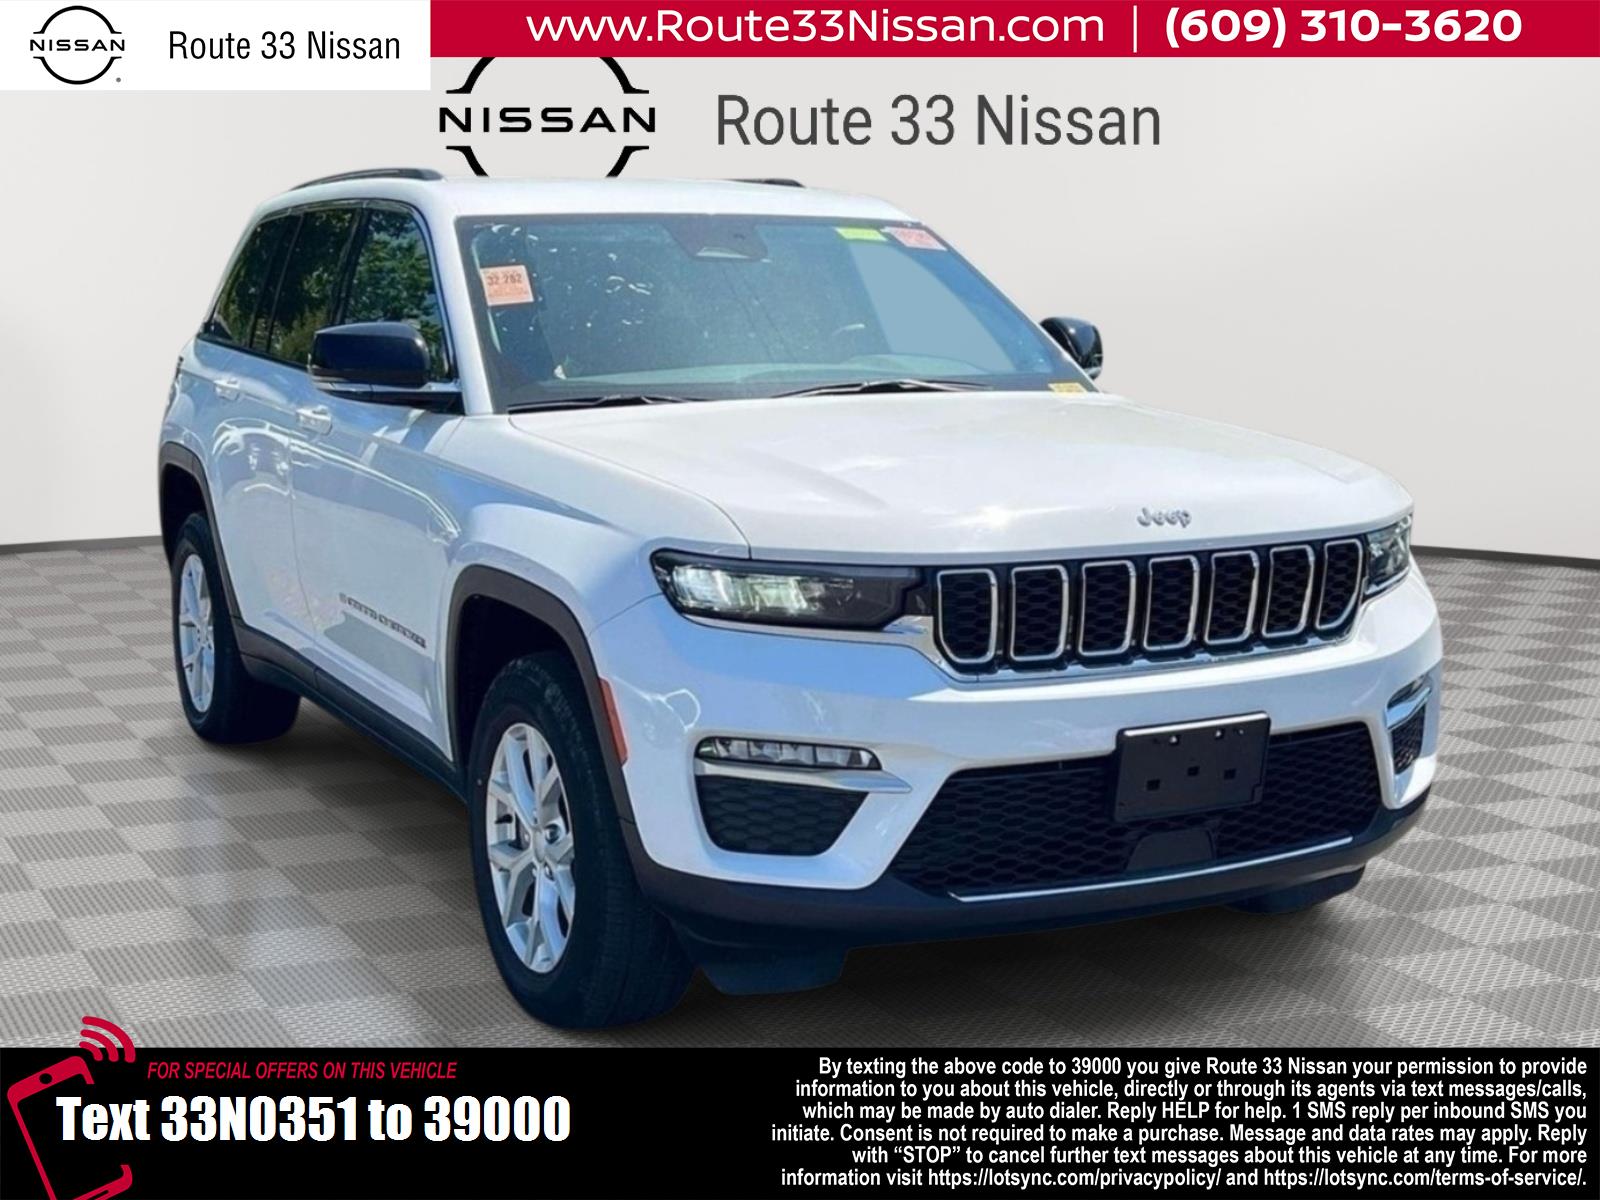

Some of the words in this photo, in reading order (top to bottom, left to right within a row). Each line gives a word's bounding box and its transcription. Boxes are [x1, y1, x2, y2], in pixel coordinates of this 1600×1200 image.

[440, 107, 655, 132] NISSAN
[718, 95, 871, 145] Route
[892, 95, 954, 145] 33
[978, 95, 1159, 145] Nissan
[1136, 506, 1192, 529] Jeep
